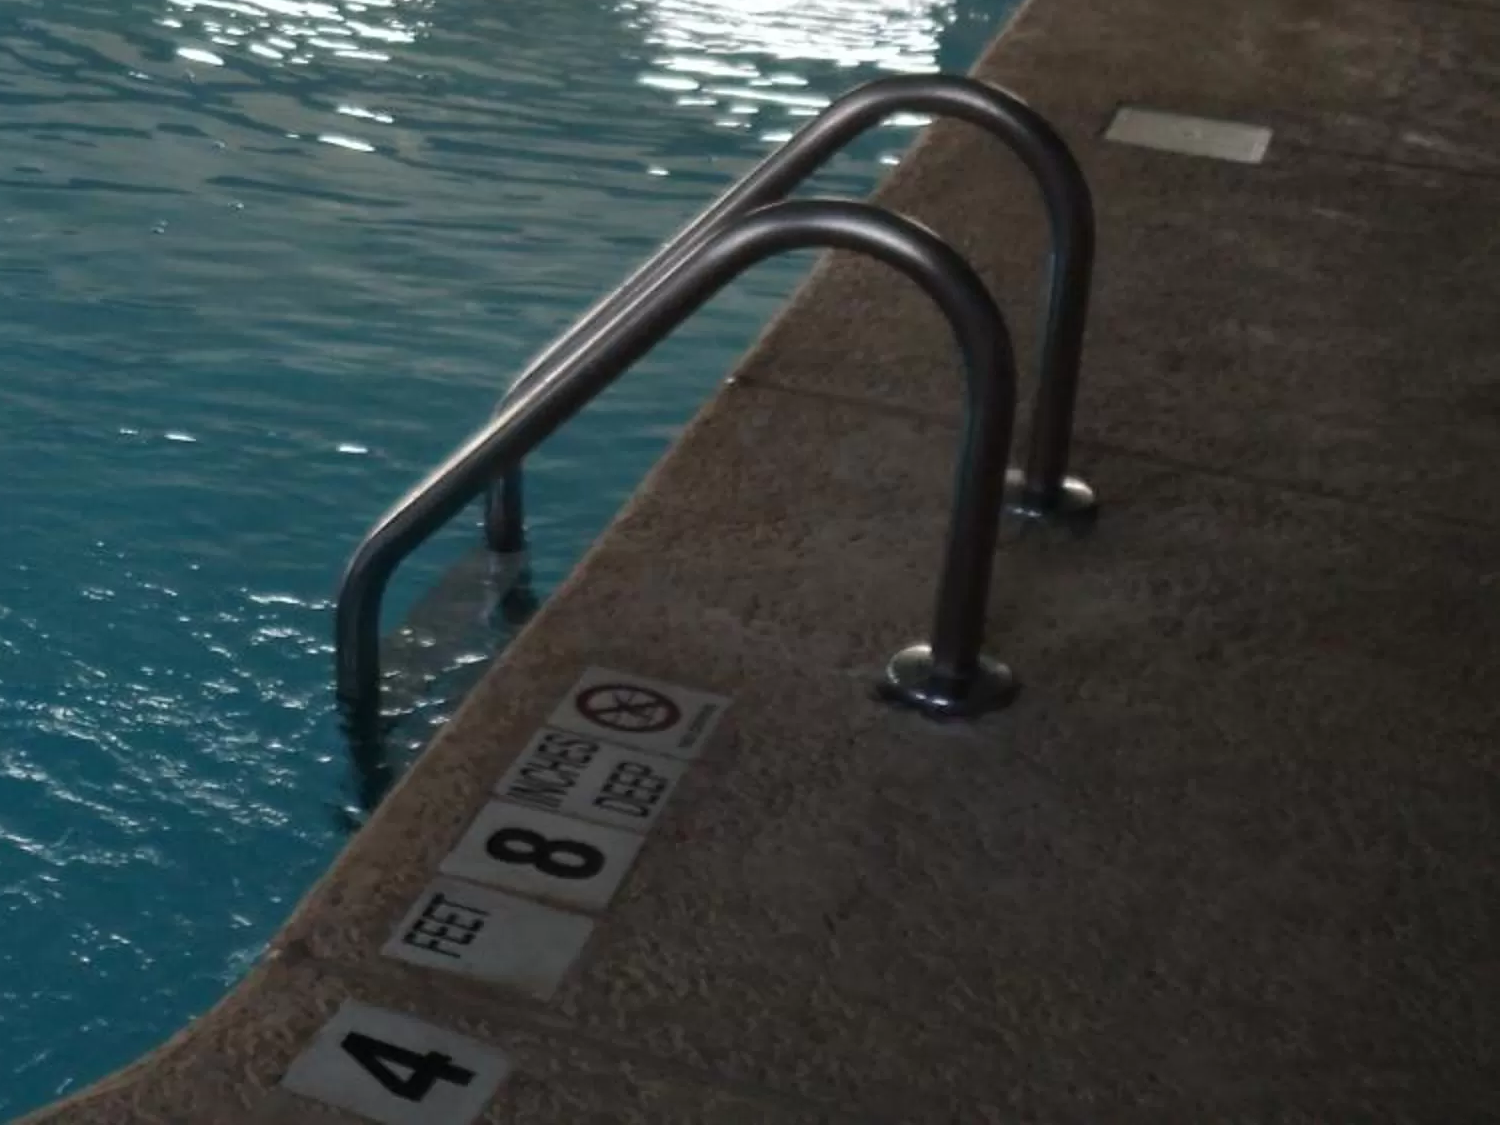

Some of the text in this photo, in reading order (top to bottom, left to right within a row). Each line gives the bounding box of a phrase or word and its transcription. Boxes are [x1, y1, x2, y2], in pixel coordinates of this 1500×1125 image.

[506, 732, 600, 811] INCHES
[593, 761, 666, 818] DEEP
[486, 827, 606, 880] 8
[403, 892, 492, 960] FEET
[340, 1030, 477, 1102] 4
